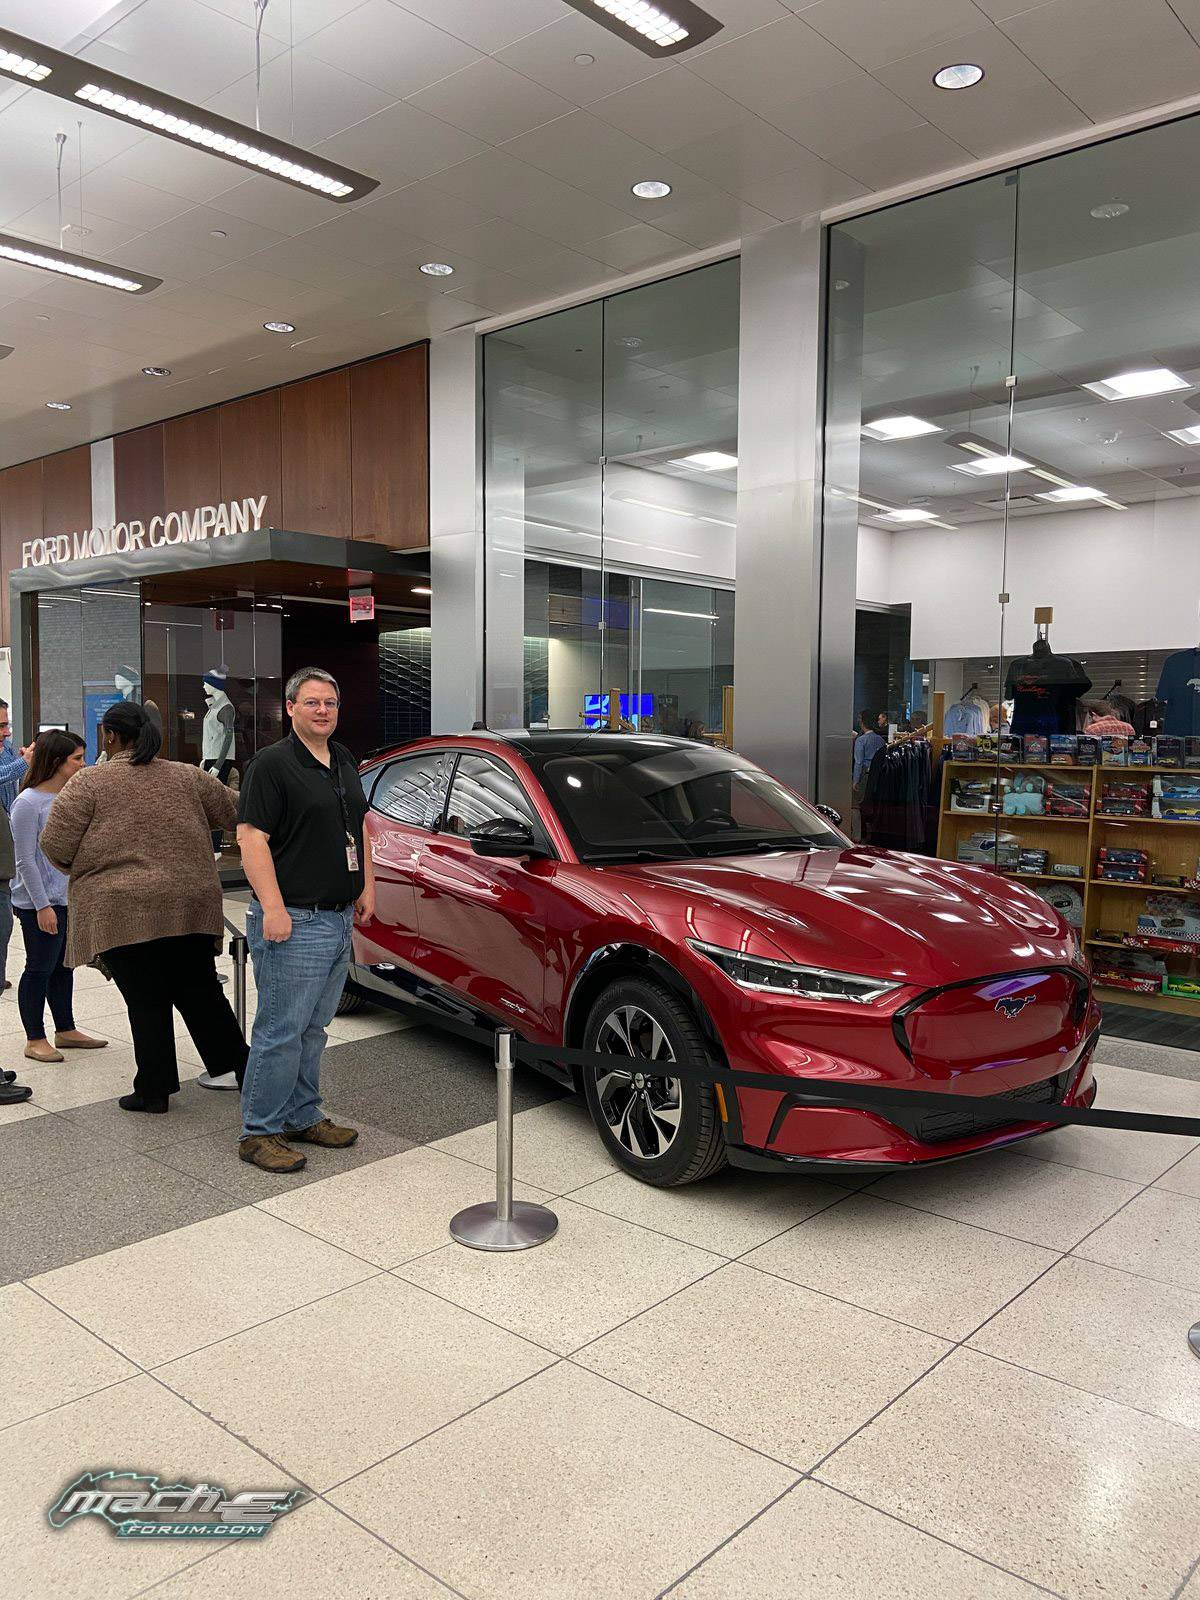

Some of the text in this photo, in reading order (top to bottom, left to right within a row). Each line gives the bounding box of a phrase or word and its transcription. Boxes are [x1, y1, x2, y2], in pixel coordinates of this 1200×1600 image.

[22, 495, 268, 569] FORD MOTOR COMPANY
